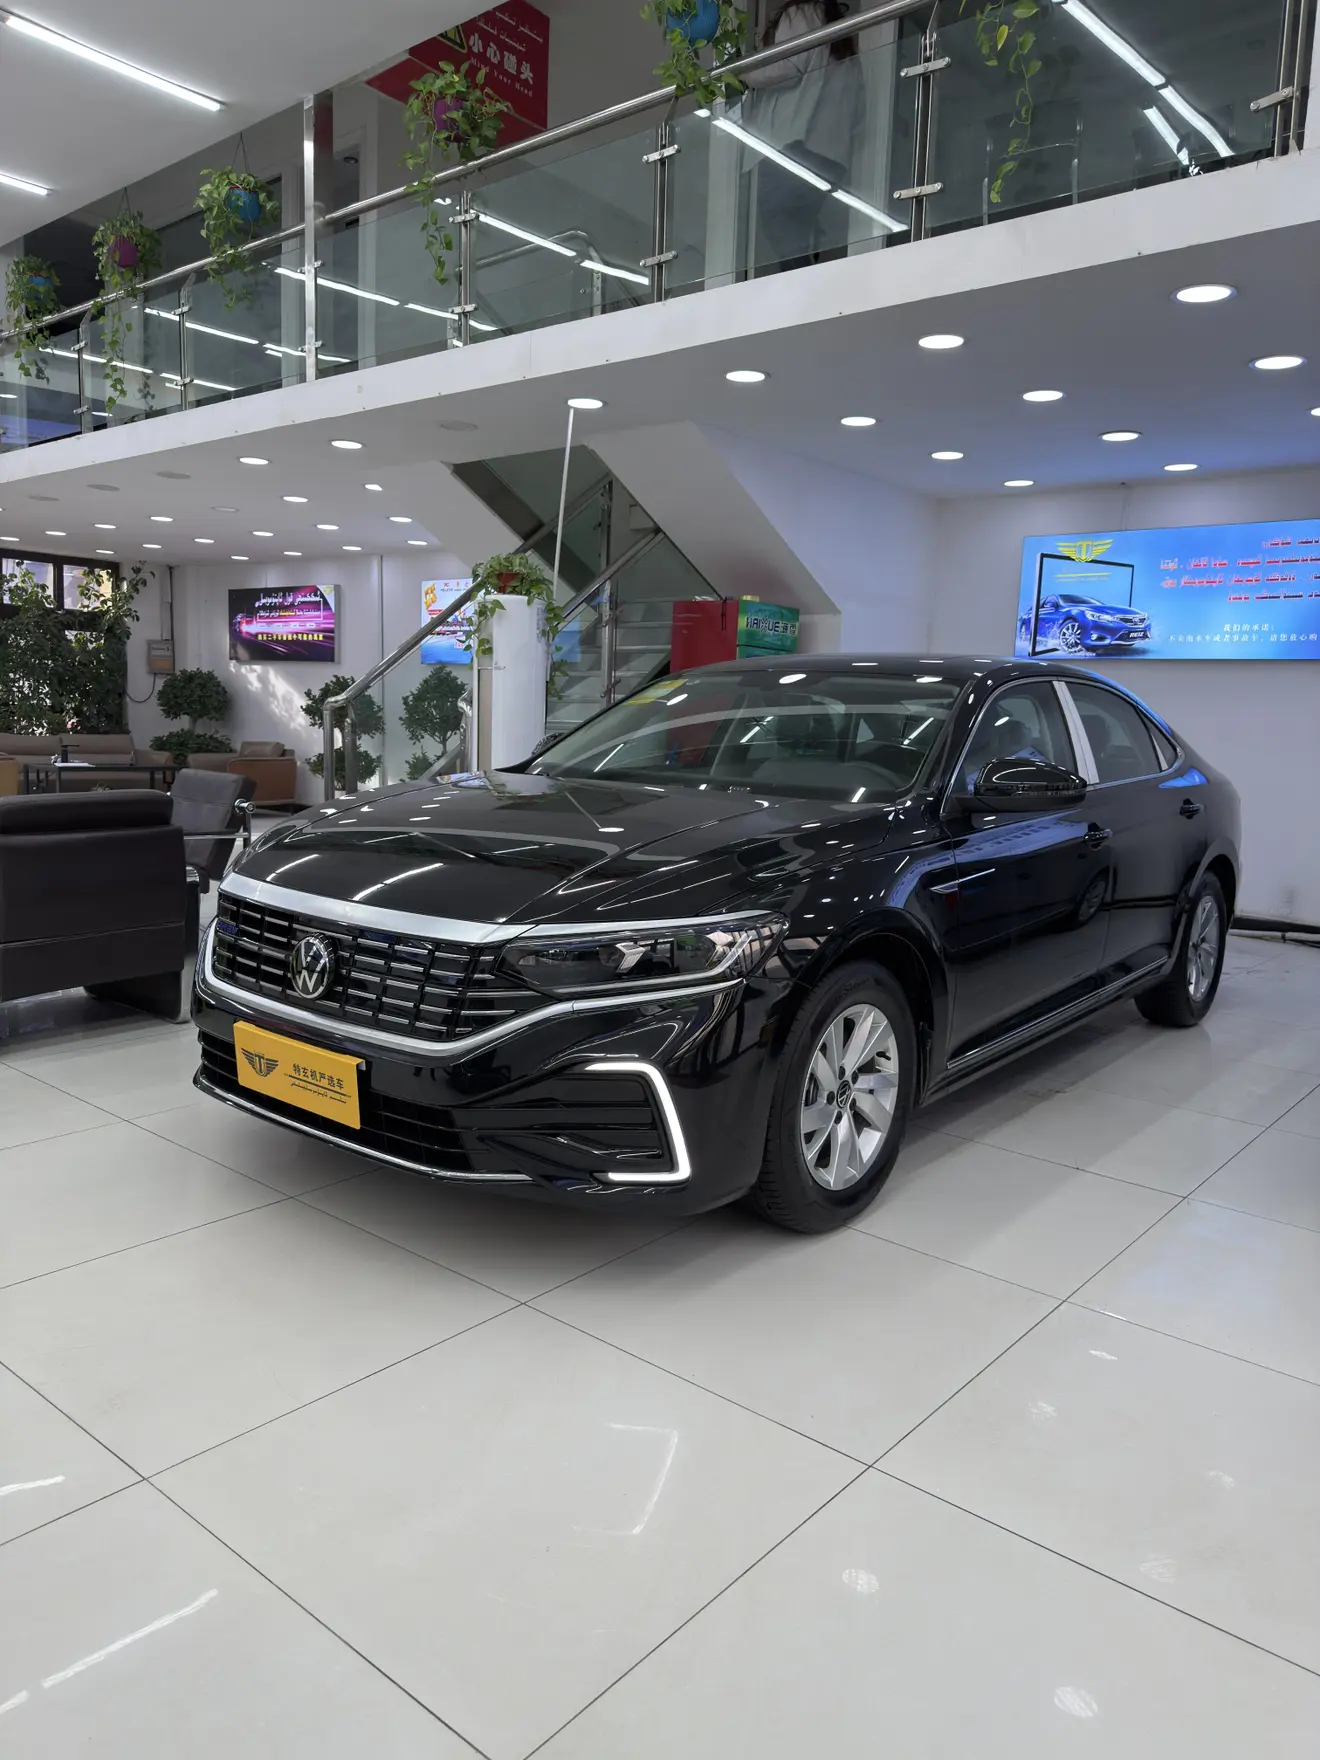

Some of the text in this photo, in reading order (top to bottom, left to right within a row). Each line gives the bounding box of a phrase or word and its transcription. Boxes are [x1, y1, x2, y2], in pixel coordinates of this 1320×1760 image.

[469, 33, 534, 85] 小心碰头
[470, 56, 533, 97] Mind Your Head
[746, 616, 780, 633] HAIXUE
[292, 1063, 345, 1091] 特玄机严选车
